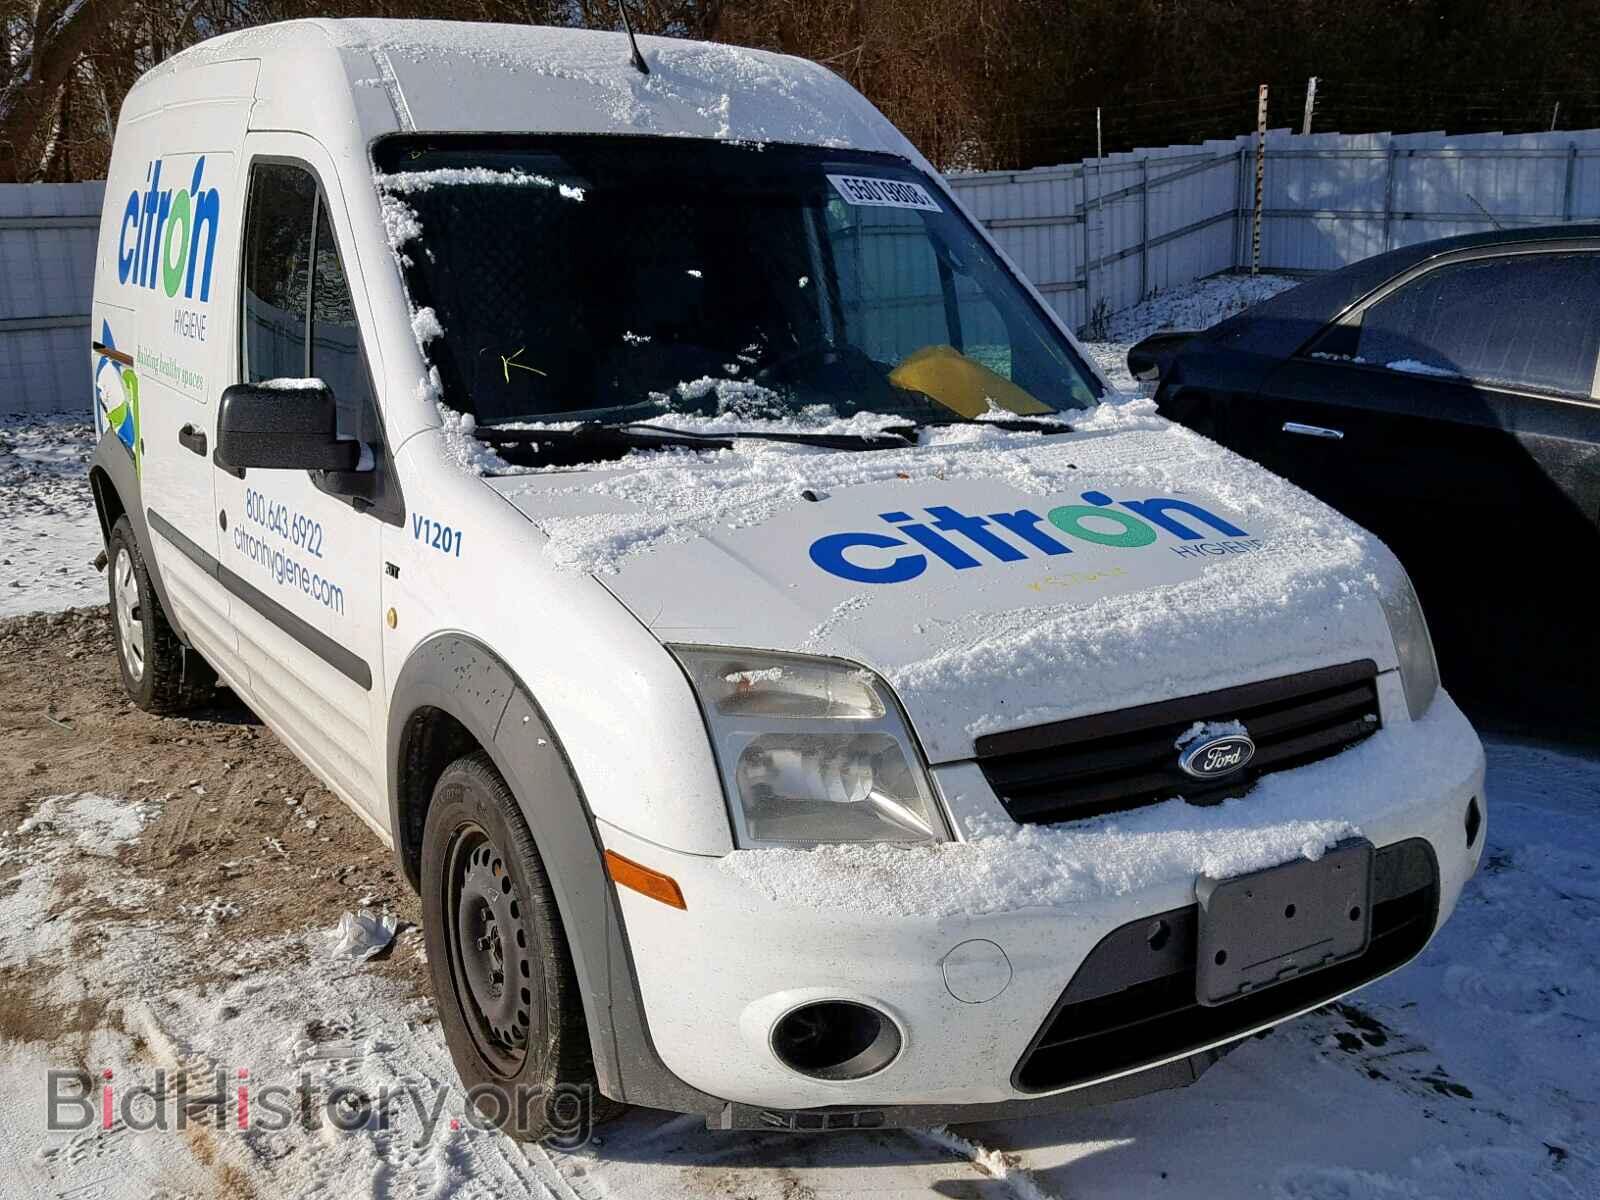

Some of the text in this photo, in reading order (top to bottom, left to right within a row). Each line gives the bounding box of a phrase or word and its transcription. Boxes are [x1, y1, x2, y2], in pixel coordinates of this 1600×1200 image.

[173, 309, 208, 344] HYGIENE
[246, 487, 323, 559] 800.643.6922
[412, 512, 463, 557] V1201
[233, 523, 345, 616] citronhygiene.com
[1203, 744, 1241, 771] Ford
